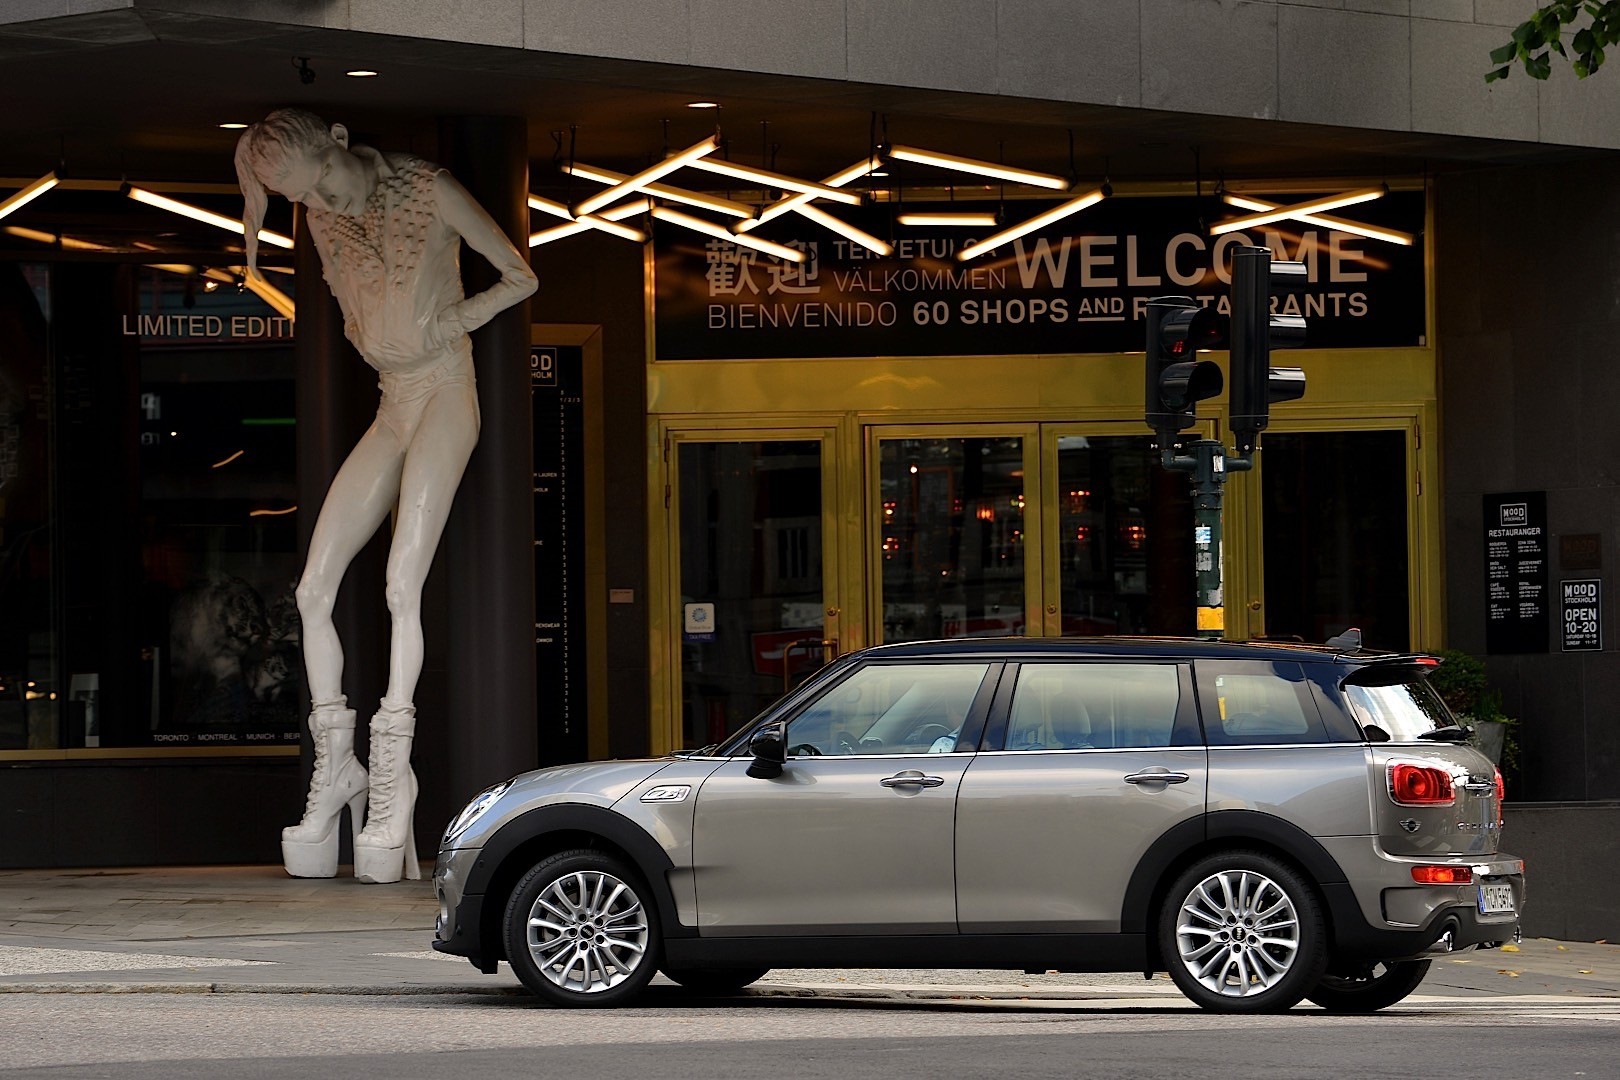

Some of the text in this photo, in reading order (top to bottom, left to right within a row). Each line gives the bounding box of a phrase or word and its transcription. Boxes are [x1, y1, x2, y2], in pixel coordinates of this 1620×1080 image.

[1013, 231, 1367, 288] WELCOME
[833, 266, 1006, 292] VÄLKOMMEN
[708, 301, 896, 328] BIENVENIDO
[913, 300, 949, 325] 60
[960, 298, 1068, 324] SHOPS
[1078, 297, 1124, 315] AND
[123, 315, 222, 337] LIMITED
[1503, 508, 1524, 518] MOOD
[1489, 527, 1541, 537] RESTAURANGER
[1565, 584, 1596, 597] MOOD
[1565, 608, 1597, 621] OPEN
[1565, 621, 1597, 633] 10-20
[153, 734, 189, 742] TORONTO
[198, 733, 238, 741] MONTREAL
